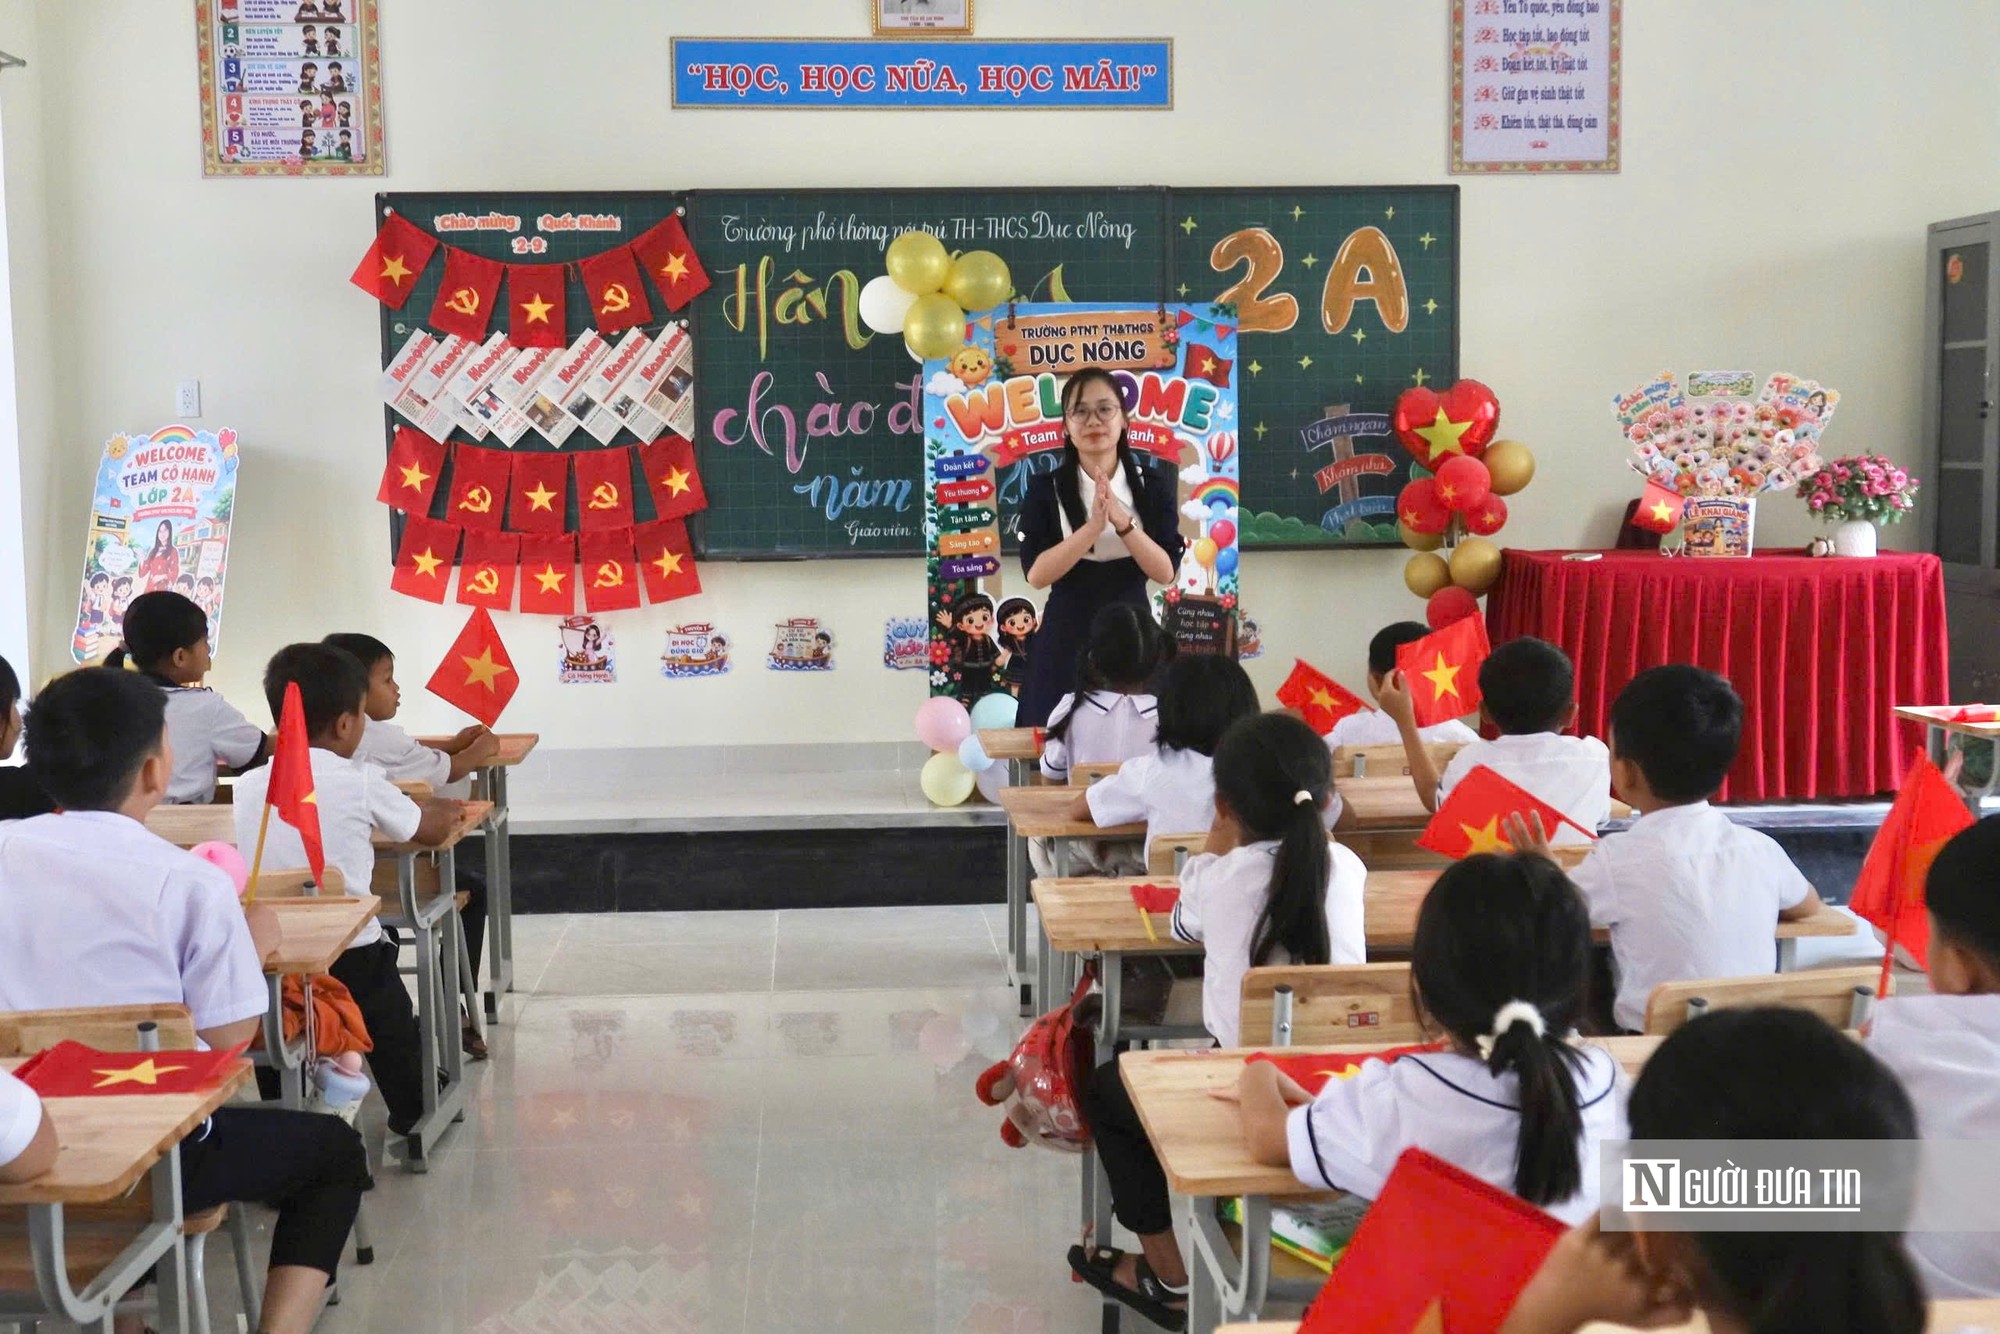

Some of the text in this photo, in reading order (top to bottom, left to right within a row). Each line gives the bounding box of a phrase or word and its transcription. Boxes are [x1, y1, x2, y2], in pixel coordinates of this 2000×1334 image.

[800, 64, 875, 97] HỌC
[886, 58, 968, 95] NỮA,
[978, 64, 1054, 97] HỌC
[439, 213, 516, 231] Chào mừng
[542, 213, 617, 230] Quốc Khánh
[721, 214, 797, 252] Trường
[801, 210, 837, 251] phổ
[839, 213, 890, 252] thông
[950, 216, 1029, 240] TH-THCS
[515, 237, 545, 251] 2-9
[1020, 325, 1067, 340] TRƯỜNG
[1070, 325, 1099, 336] PTNT
[1029, 336, 1146, 369] DỤC NÔNG
[945, 370, 1219, 440] WELOME
[1021, 430, 1058, 446] Team
[134, 446, 207, 467] WELCOME
[943, 460, 975, 473] Đoàn kết
[122, 464, 216, 488] TEAM CÔ HẠNH
[137, 486, 194, 506] LỚP 2A
[793, 465, 915, 522] năm
[943, 489, 958, 499] Yêu
[964, 514, 979, 524] tâm
[844, 520, 883, 546] Giáo
[949, 540, 967, 550] Sáng
[966, 563, 983, 575] sáng
[1196, 607, 1215, 618] nhau
[1194, 631, 1213, 641] nhau
